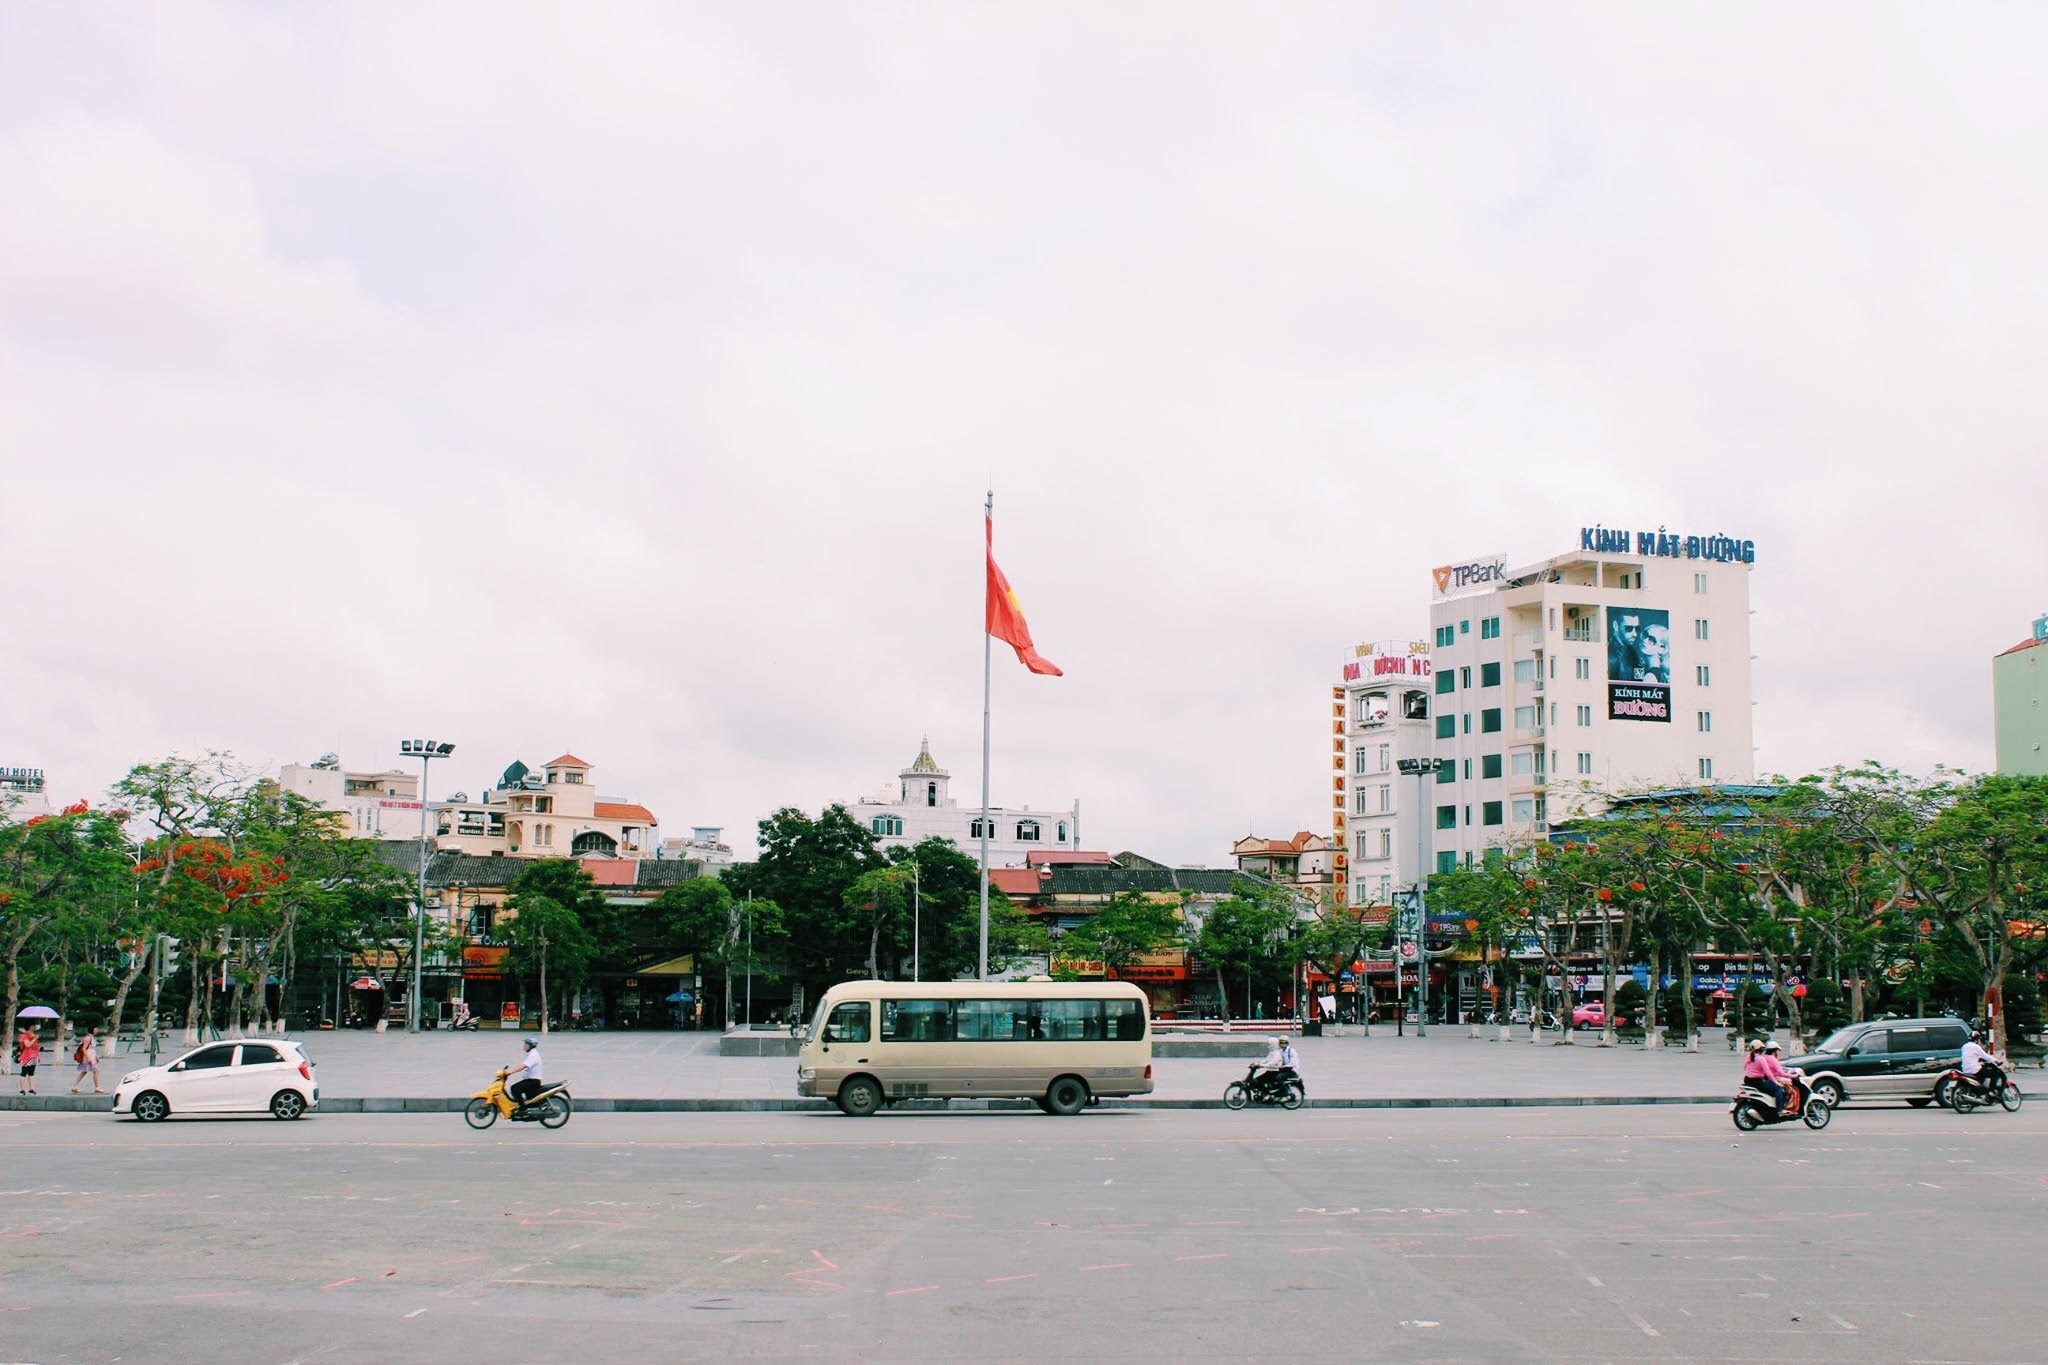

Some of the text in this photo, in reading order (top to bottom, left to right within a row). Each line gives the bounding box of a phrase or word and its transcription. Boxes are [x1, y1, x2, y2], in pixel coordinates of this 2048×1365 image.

[1581, 523, 1630, 553] KÍNH
[1686, 532, 1755, 564] ĐƯỜNG
[1453, 559, 1506, 588] TPBank
[1614, 686, 1640, 698] KÍNH
[1613, 698, 1667, 718] ĐƯỜNG
[12, 767, 45, 778] HOTEL
